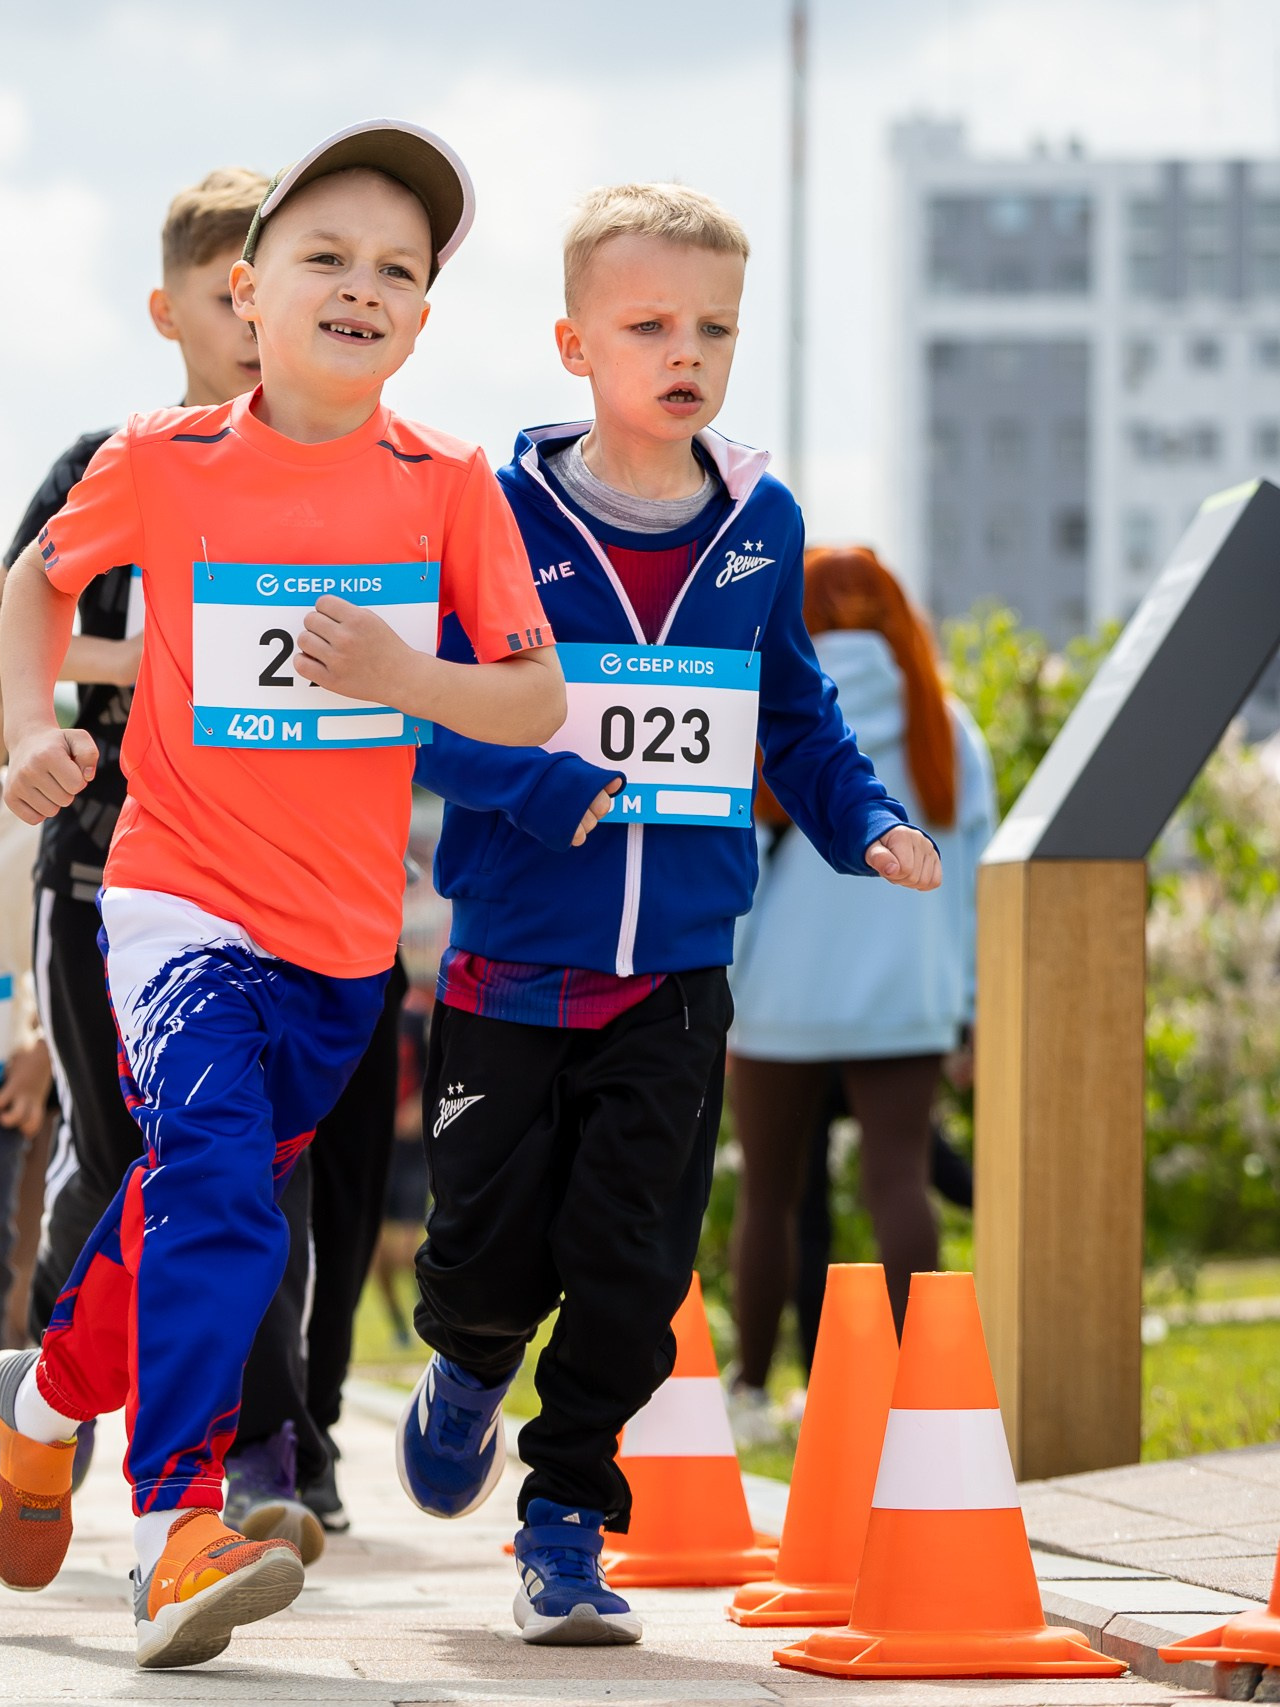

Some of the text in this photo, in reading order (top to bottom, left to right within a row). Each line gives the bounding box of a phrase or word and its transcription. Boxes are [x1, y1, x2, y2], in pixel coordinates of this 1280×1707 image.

[283, 577, 382, 593] СБЕР KIDS
[626, 657, 715, 675] СБЕР KIDS
[227, 714, 275, 740] 420
[600, 705, 711, 764] 023
